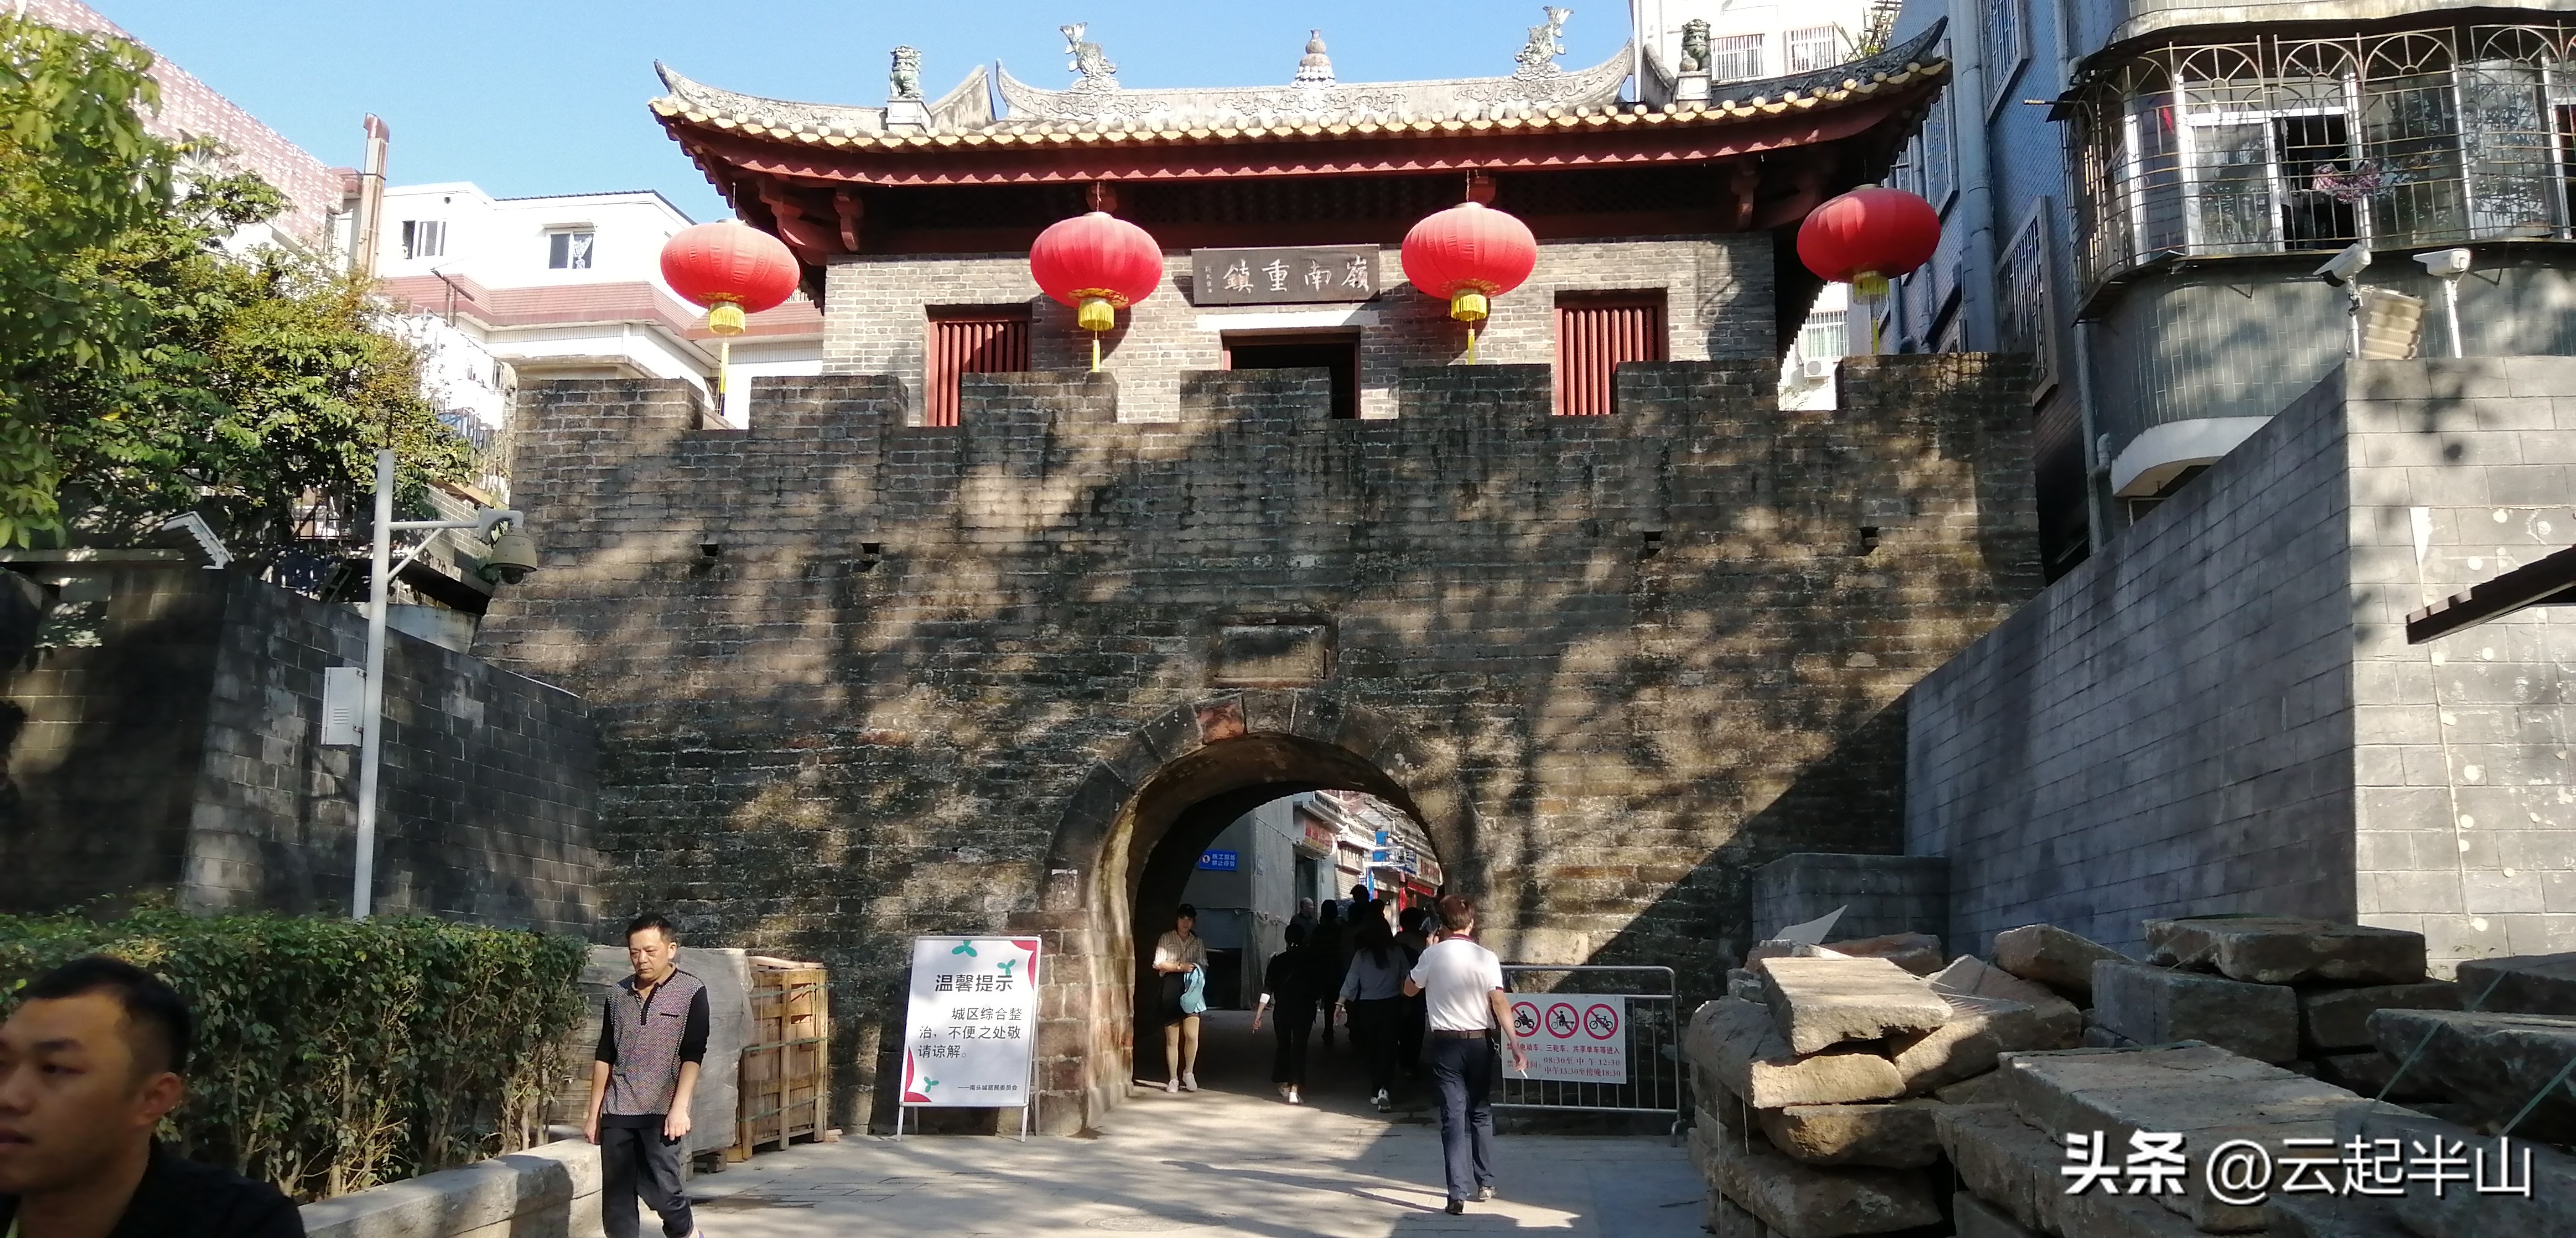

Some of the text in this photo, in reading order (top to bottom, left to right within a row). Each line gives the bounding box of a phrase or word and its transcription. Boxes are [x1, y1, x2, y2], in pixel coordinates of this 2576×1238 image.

[934, 974, 1014, 992] 温馨提示
[951, 1007, 1022, 1021] 城区综合整
[918, 1044, 967, 1058] 请谅解。
[1507, 1042, 1620, 1055] 禁电动车、三轮车、共享单车等进入
